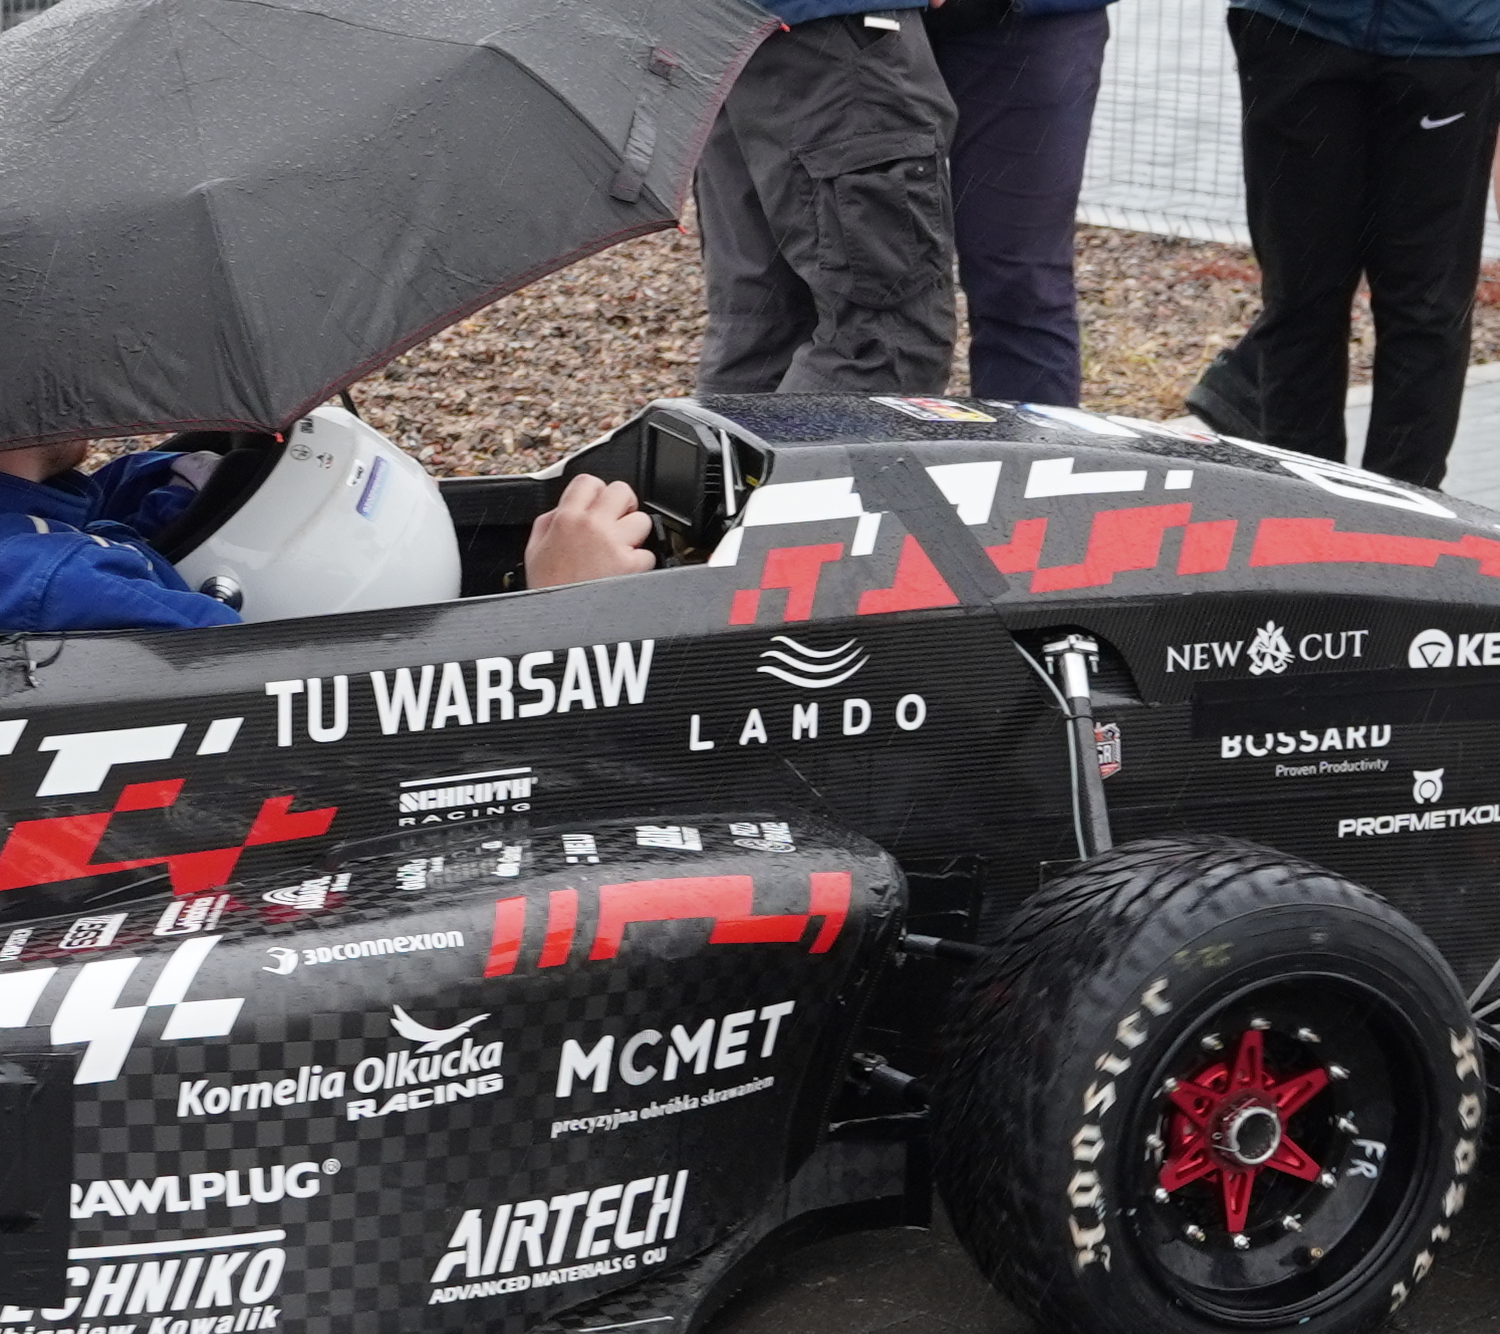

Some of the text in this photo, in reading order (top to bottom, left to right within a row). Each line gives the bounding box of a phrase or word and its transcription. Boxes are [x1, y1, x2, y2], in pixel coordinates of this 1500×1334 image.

[1165, 630, 1368, 672] NEW CUT
[266, 639, 654, 747] TU WARSAW
[689, 694, 926, 751] LAMDO
[1275, 759, 1388, 778] Proven Productivity
[398, 803, 530, 827] RACING
[556, 1000, 795, 1097] MCMET
[177, 1038, 503, 1117] Kornelia Olkucka
[347, 1073, 503, 1121] RACING
[551, 1076, 774, 1138] precyzyjna obróbka skrawaniem
[1346, 1138, 1386, 1179] FR
[430, 1169, 688, 1283] AIRTECH
[428, 1276, 531, 1305] ADVANCED
[532, 1258, 620, 1288] MATERIALS
